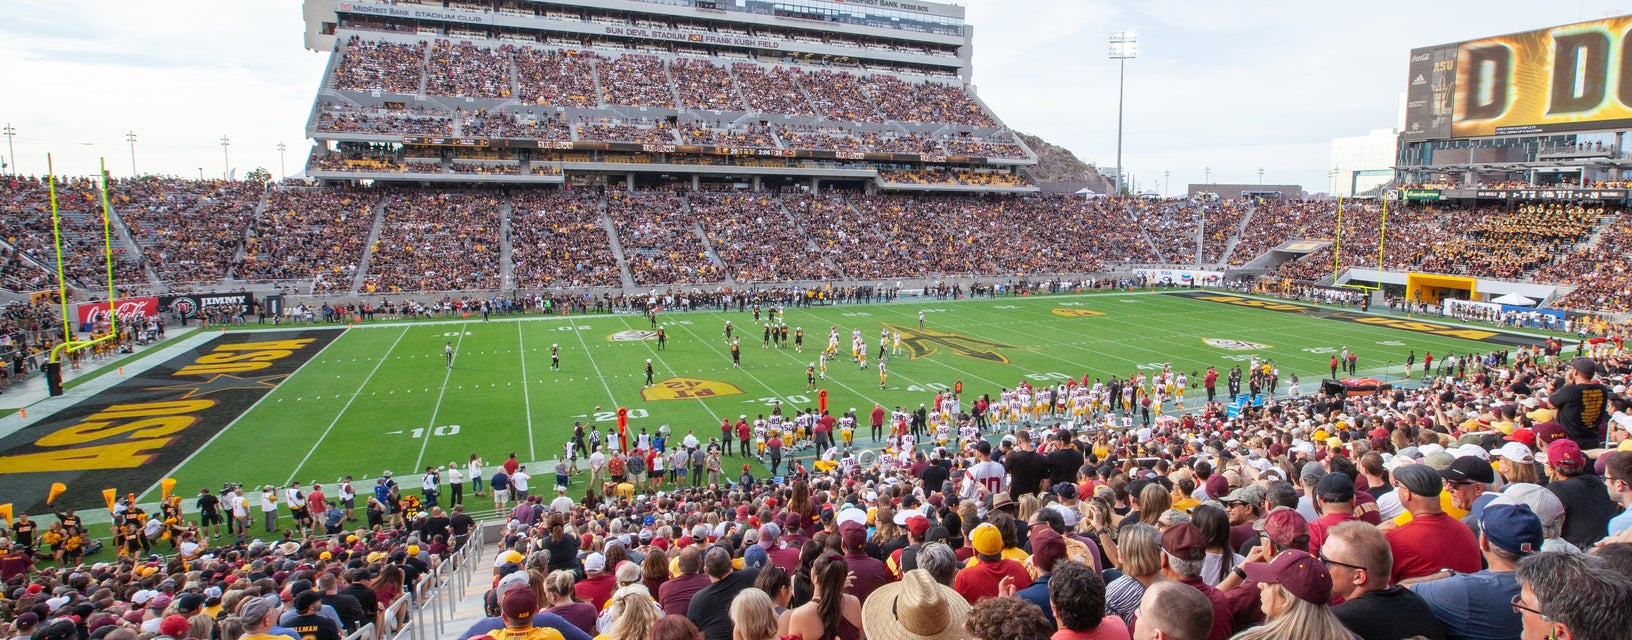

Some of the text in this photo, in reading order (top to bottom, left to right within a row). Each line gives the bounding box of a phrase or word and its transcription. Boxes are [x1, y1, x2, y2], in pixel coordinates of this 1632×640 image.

[390, 8, 410, 16] BANK
[414, 11, 456, 20] STADIUM
[457, 14, 482, 22] CLUB
[605, 26, 624, 35] SUN
[626, 28, 650, 37] DEVIL
[651, 30, 686, 41] STADIUM
[705, 35, 732, 44] FRANK
[734, 38, 756, 47] KUSH
[758, 40, 779, 49] FIELD
[1433, 60, 1454, 72] ASU
[201, 296, 246, 306] JIMMY
[171, 338, 317, 376] ASU
[1025, 371, 1071, 381] 50
[907, 382, 949, 392] 40
[759, 394, 811, 406] 30
[593, 408, 650, 422] 20
[0, 399, 220, 474] ASU
[411, 424, 461, 439] 10
[979, 476, 1001, 501] 10
[406, 511, 419, 522] 42
